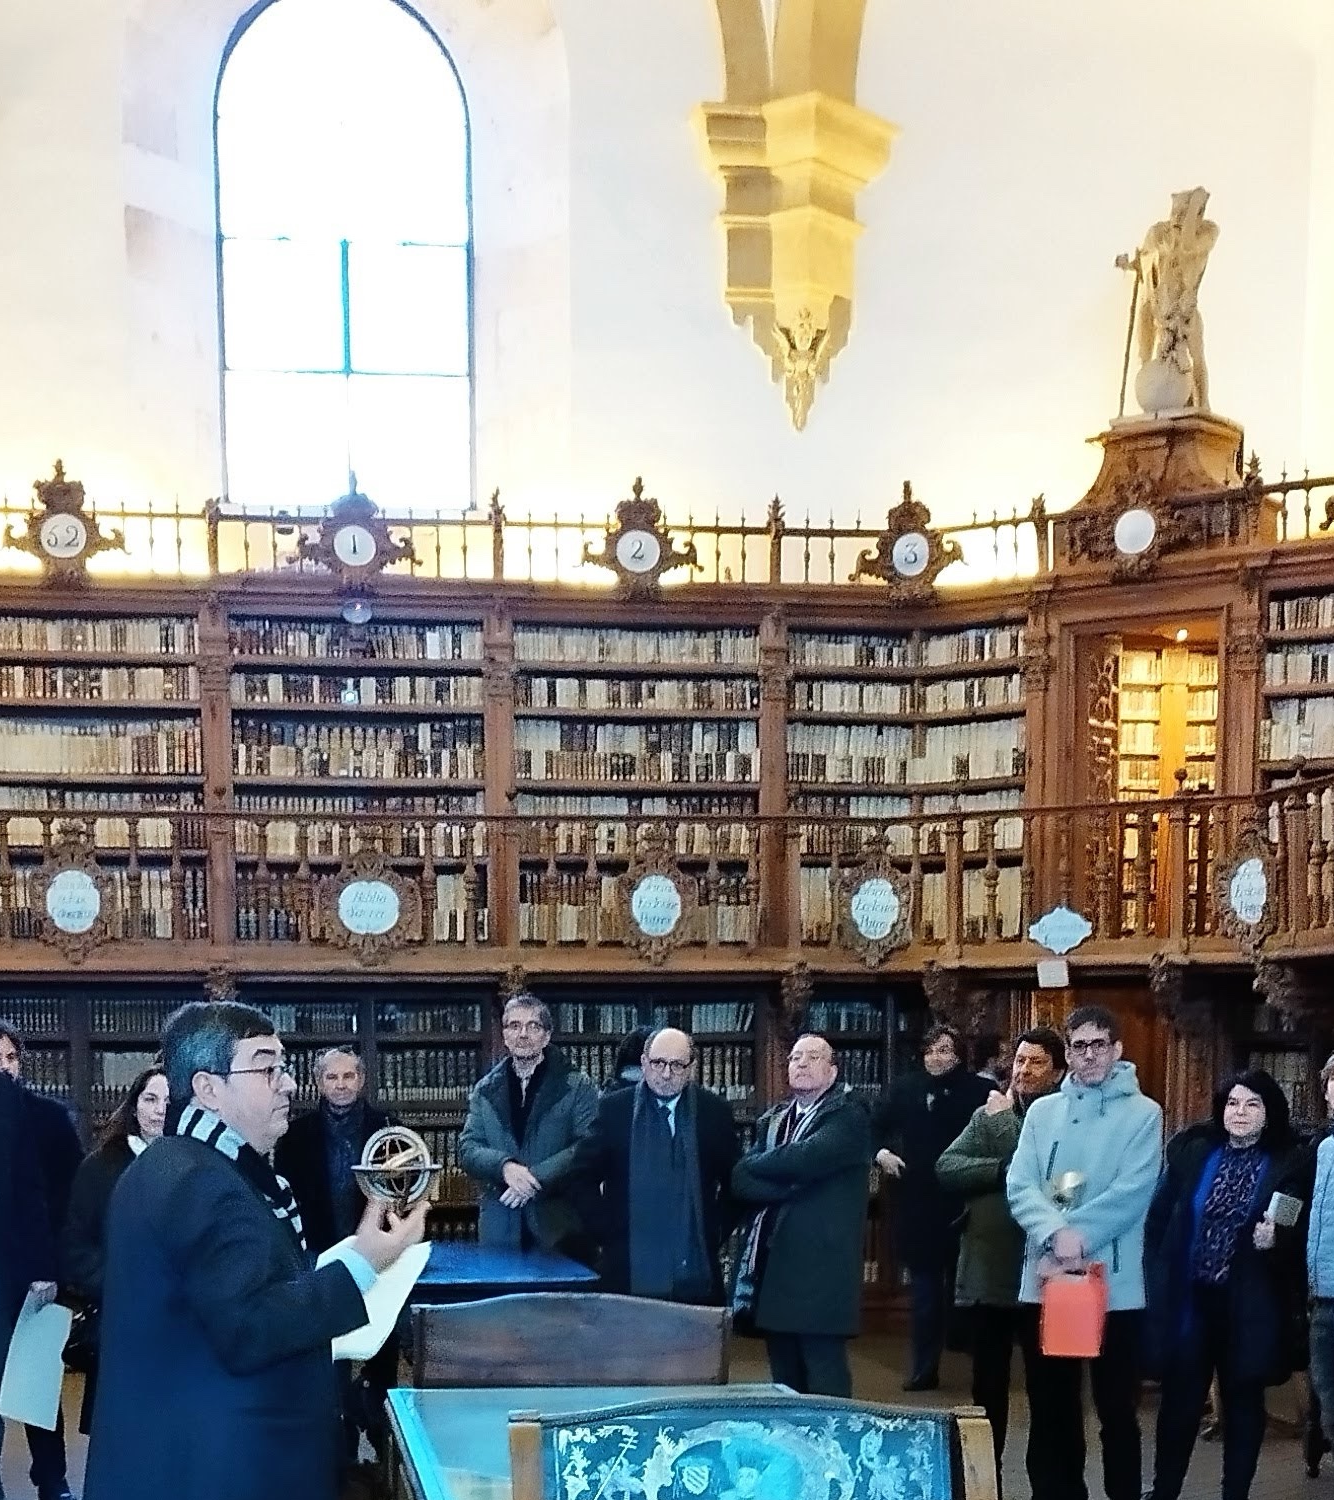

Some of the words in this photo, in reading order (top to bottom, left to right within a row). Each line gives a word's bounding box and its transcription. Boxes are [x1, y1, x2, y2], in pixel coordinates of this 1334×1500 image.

[45, 524, 80, 548] 52
[351, 534, 358, 555] 1
[631, 539, 645, 562] 2
[904, 542, 919, 566] 3
